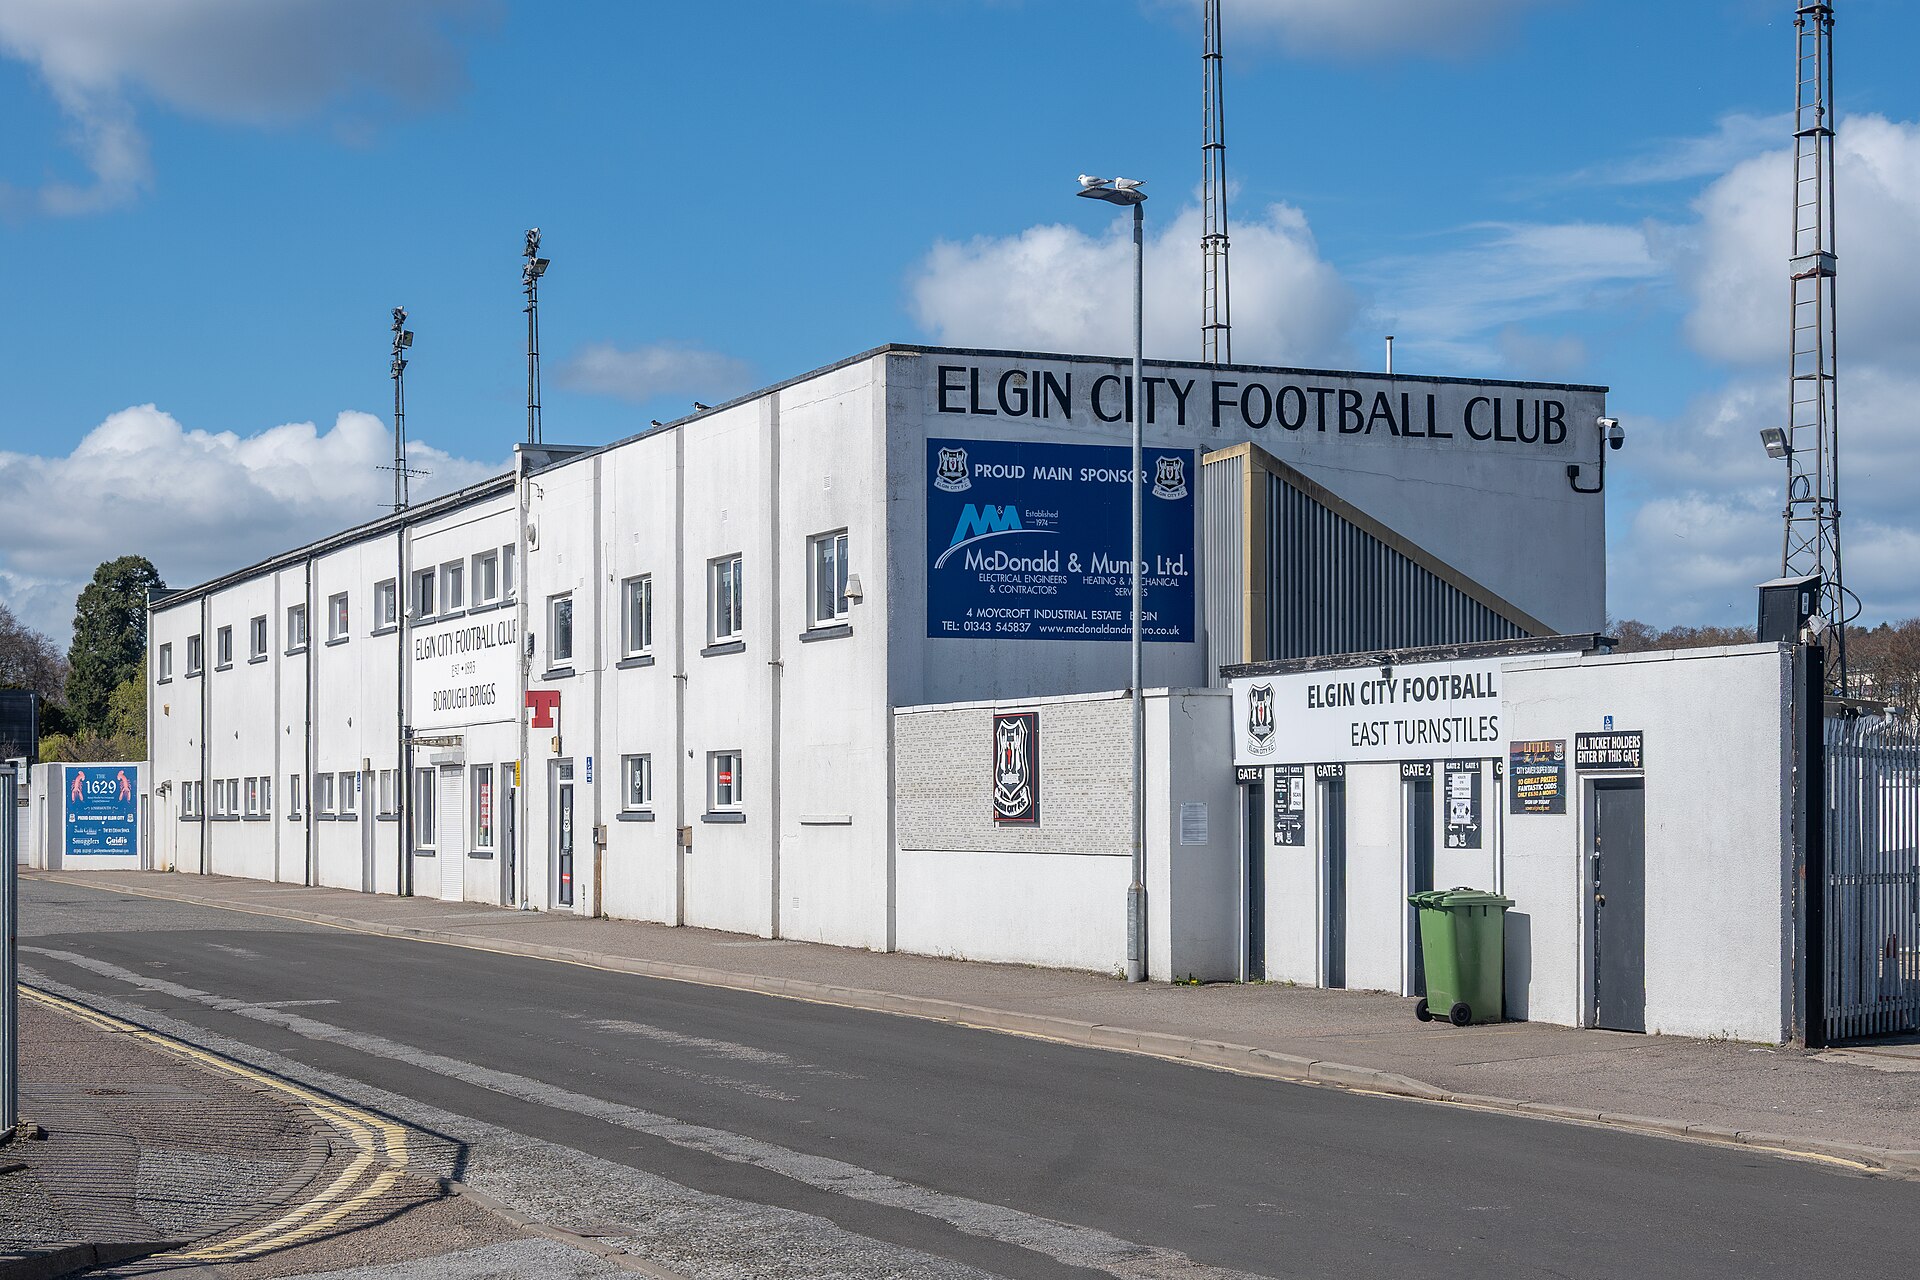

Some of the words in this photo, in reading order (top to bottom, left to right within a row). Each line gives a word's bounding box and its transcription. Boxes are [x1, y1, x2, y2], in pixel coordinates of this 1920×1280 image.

[938, 365, 1072, 420] ELGIN
[1091, 375, 1195, 426] CITY
[1212, 381, 1453, 439] FOOTBALL
[1463, 396, 1567, 444] CLUB
[975, 463, 1025, 480] PROUD
[1033, 466, 1073, 482] MAIN
[1025, 510, 1059, 518] Established
[965, 549, 1060, 573] McDonald
[1068, 553, 1082, 573] &
[1157, 554, 1189, 577] Ltd.
[978, 573, 1022, 583] ELECTRICAL
[1024, 574, 1067, 585] ENGINEERS
[1082, 576, 1117, 586] HEATING
[1119, 577, 1126, 586] &
[1128, 577, 1179, 588] MCHANICAL
[989, 585, 996, 594] &
[999, 585, 1058, 595] CONTRACTORS
[966, 608, 973, 617] 4
[976, 608, 1031, 619] MOYCROFT
[1034, 609, 1088, 620] INDUSTRIAL
[1091, 610, 1122, 621] ESTATE
[1129, 611, 1158, 622] EGIN
[942, 621, 960, 631] TEL:
[964, 621, 991, 632] 01343
[995, 622, 1031, 633] 545837
[1039, 623, 1180, 635] www.mcdonaldandmnro.co.uk
[416, 636, 436, 661] ELGIN
[437, 632, 454, 658] CITY
[455, 623, 496, 653] FOOTBALL
[433, 688, 468, 712] BOROUGH
[470, 683, 496, 706] BRIGGS
[1307, 682, 1355, 709] ELGIN
[1360, 678, 1398, 705] CITY
[1403, 672, 1498, 702] FOOTBALL
[1351, 721, 1390, 747] EAST
[1394, 715, 1499, 745] TURNSTILES
[1523, 741, 1551, 753] LITTLE
[1577, 737, 1589, 750] ALL
[1589, 736, 1611, 749] TICKET
[1612, 735, 1641, 749] HOLDERS
[1577, 751, 1597, 763] ENTER
[1598, 751, 1607, 763] BY
[1607, 750, 1622, 763] THIS
[1623, 749, 1640, 763] GATE
[1238, 768, 1257, 780] GATE
[1257, 768, 1263, 779] 4
[1316, 764, 1335, 777] GATE
[1337, 763, 1343, 776] 3
[1402, 762, 1422, 776] GATE
[1424, 761, 1431, 775] 2
[1540, 775, 1557, 783] PRIZES
[86, 780, 117, 794] 1629
[1517, 784, 1543, 792] FANTASTIC
[72, 838, 100, 846] Smugglers
